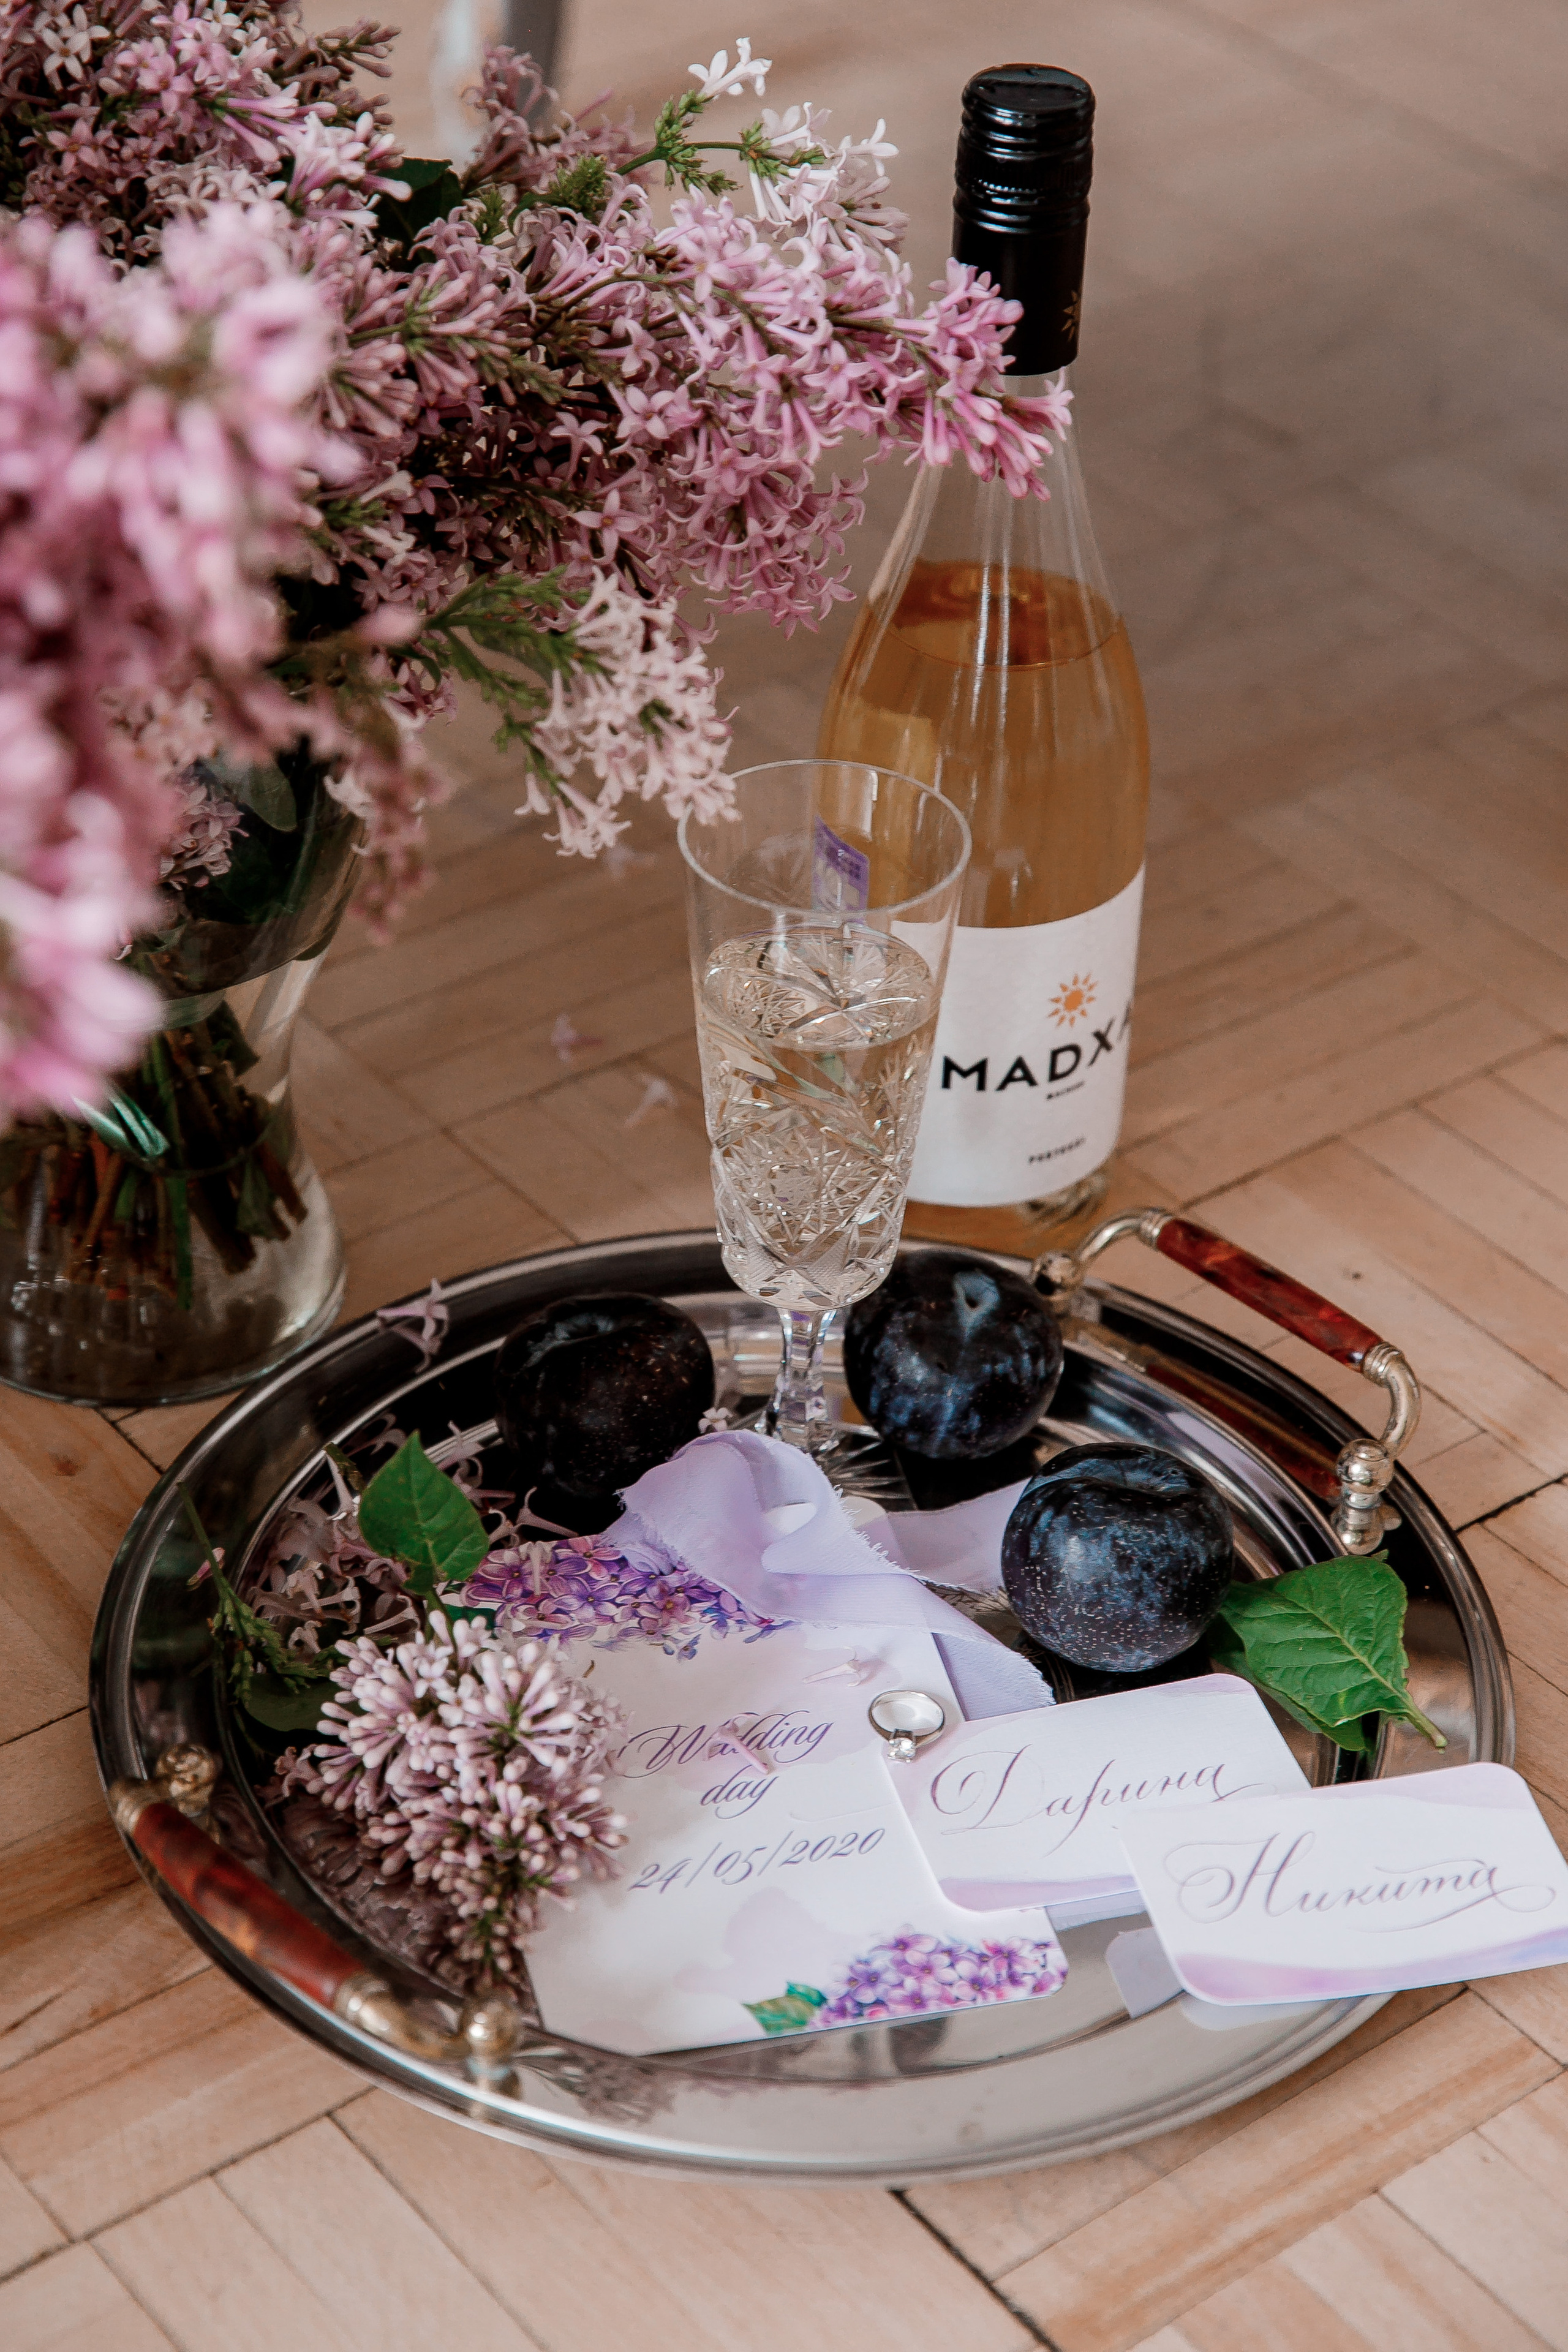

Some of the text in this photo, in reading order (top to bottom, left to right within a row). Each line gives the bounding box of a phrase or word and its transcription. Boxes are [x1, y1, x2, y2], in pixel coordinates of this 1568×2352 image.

[699, 1764, 780, 1820] day
[930, 1743, 1268, 1858] Дарина
[628, 1828, 886, 1894] 24/05/2020
[1163, 1831, 1557, 1933] Никита
